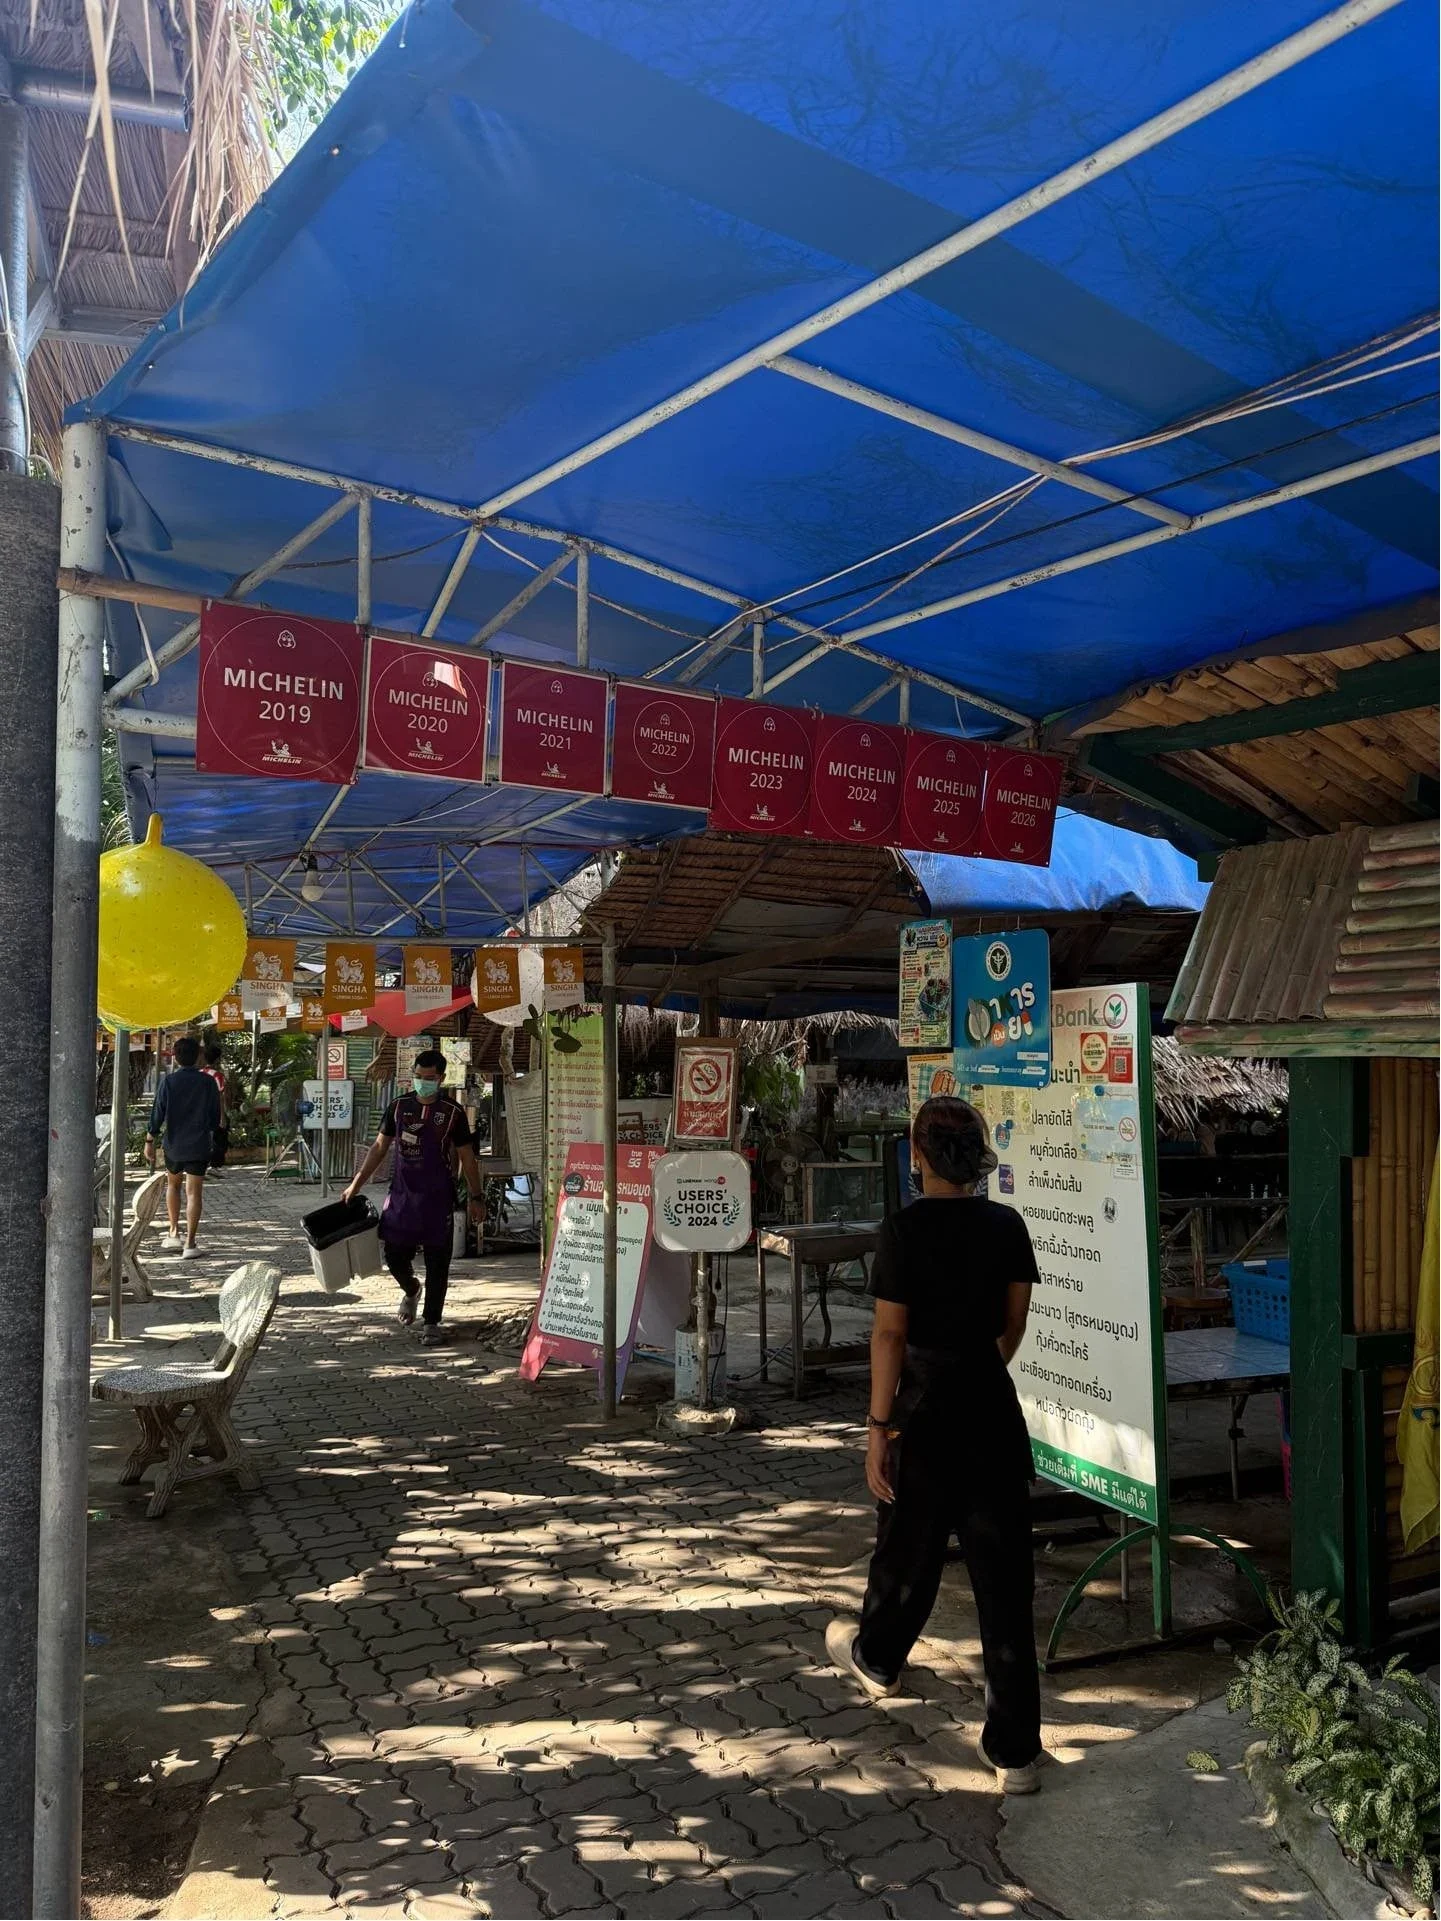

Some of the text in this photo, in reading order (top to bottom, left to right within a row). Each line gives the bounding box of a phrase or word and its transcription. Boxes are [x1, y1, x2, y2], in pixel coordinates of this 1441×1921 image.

[224, 667, 344, 701] MICHELIN
[388, 689, 469, 716] MICHELIN
[258, 701, 312, 725] 2019
[517, 708, 594, 734] MICHELIN
[407, 714, 449, 734] 2020
[539, 732, 572, 751] 2021
[639, 727, 690, 744] MICHELIN
[407, 751, 444, 761] MICHELIN
[651, 742, 678, 758] 2022
[728, 747, 804, 771] MICHELIN
[261, 755, 302, 765] MICHELIN
[749, 773, 783, 790] 2023
[828, 761, 896, 785] MICHELIN
[847, 786, 877, 803] 2024
[917, 775, 976, 799] MICHELIN
[933, 799, 960, 816] 2025
[996, 788, 1051, 811] MICHELIN
[1010, 811, 1036, 828] 2026
[250, 981, 285, 991] SINGHA
[332, 985, 367, 994] SINGHA
[412, 985, 444, 993] SINGHA
[483, 985, 513, 993] SINGHA
[550, 983, 578, 992] SINGHA
[1051, 998, 1100, 1028] Bank
[312, 1096, 344, 1104] USRS'
[316, 1104, 344, 1112] HICE
[1031, 1109, 1072, 1128] ปลายัดไส้
[1030, 1137, 1077, 1162] หมูคั่วเกลือ
[627, 1158, 641, 1169] 5G
[678, 1189, 727, 1201] USERS'
[674, 1202, 730, 1214] CHOICE
[687, 1216, 718, 1227] 2024
[1022, 1205, 1094, 1233] หอยขมผัดชะพลู
[1039, 1265, 1083, 1293] ำสาหร่าย
[1064, 1305, 1139, 1341] (สูตรหมอมูดง)
[1036, 1329, 1089, 1361] กุ้งคั่วตะไคร้
[1020, 1360, 1112, 1402] มะเขือยาวทอดเครื่อง
[1080, 1470, 1109, 1496] SME
[1112, 1481, 1148, 1511] มีแต่ได้
